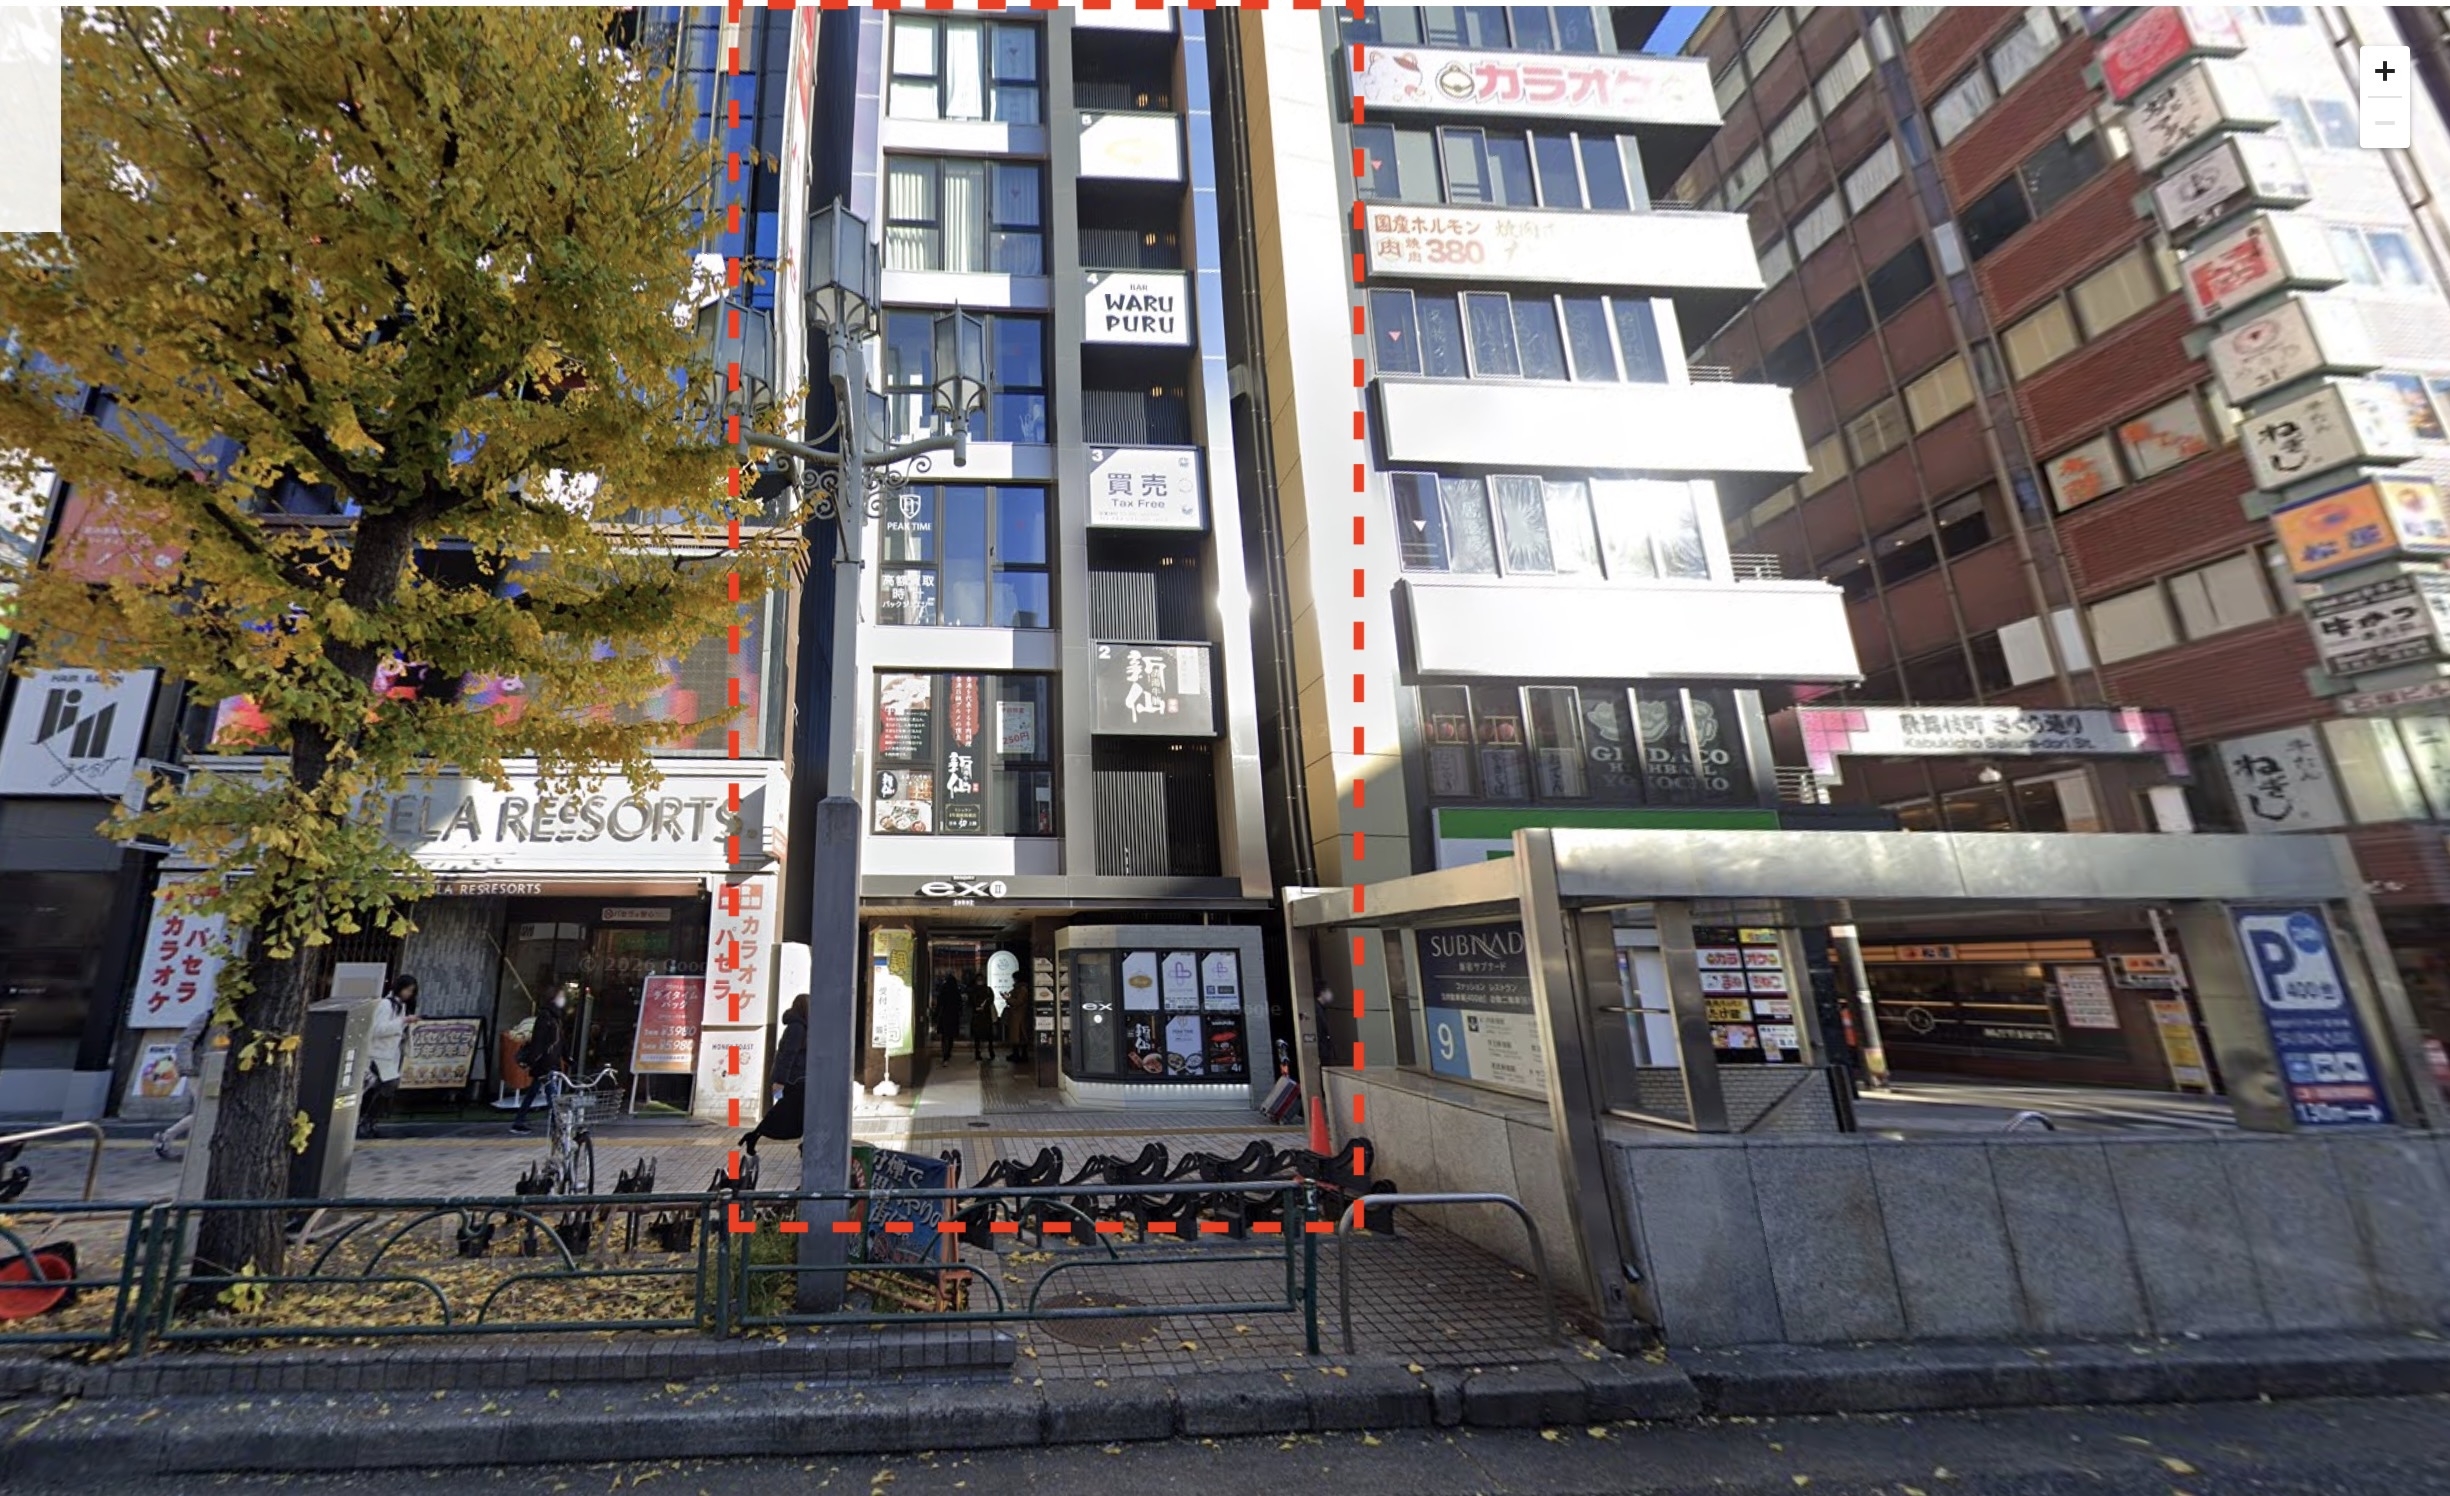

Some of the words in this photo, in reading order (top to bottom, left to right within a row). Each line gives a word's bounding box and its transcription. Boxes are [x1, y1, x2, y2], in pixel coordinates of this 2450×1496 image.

[1374, 213, 1481, 235] 国産ホルモン
[1426, 239, 1485, 264] 380
[1104, 294, 1174, 313] WARU
[1105, 315, 1174, 333] PURU
[1091, 449, 1104, 461] 3
[1111, 499, 1134, 507] Tax
[1138, 500, 1166, 508] Free
[887, 522, 909, 531] PEAK
[1098, 646, 1111, 659] 2
[1899, 713, 1984, 736] 歌舞伎町
[921, 881, 990, 897] ex
[146, 915, 185, 1014] カラオケ
[176, 926, 212, 1004] パセラ
[739, 915, 761, 1010] カラオケ
[2248, 929, 2296, 1001] P
[1082, 1002, 1113, 1011] ex
[1437, 1022, 1455, 1061] 9
